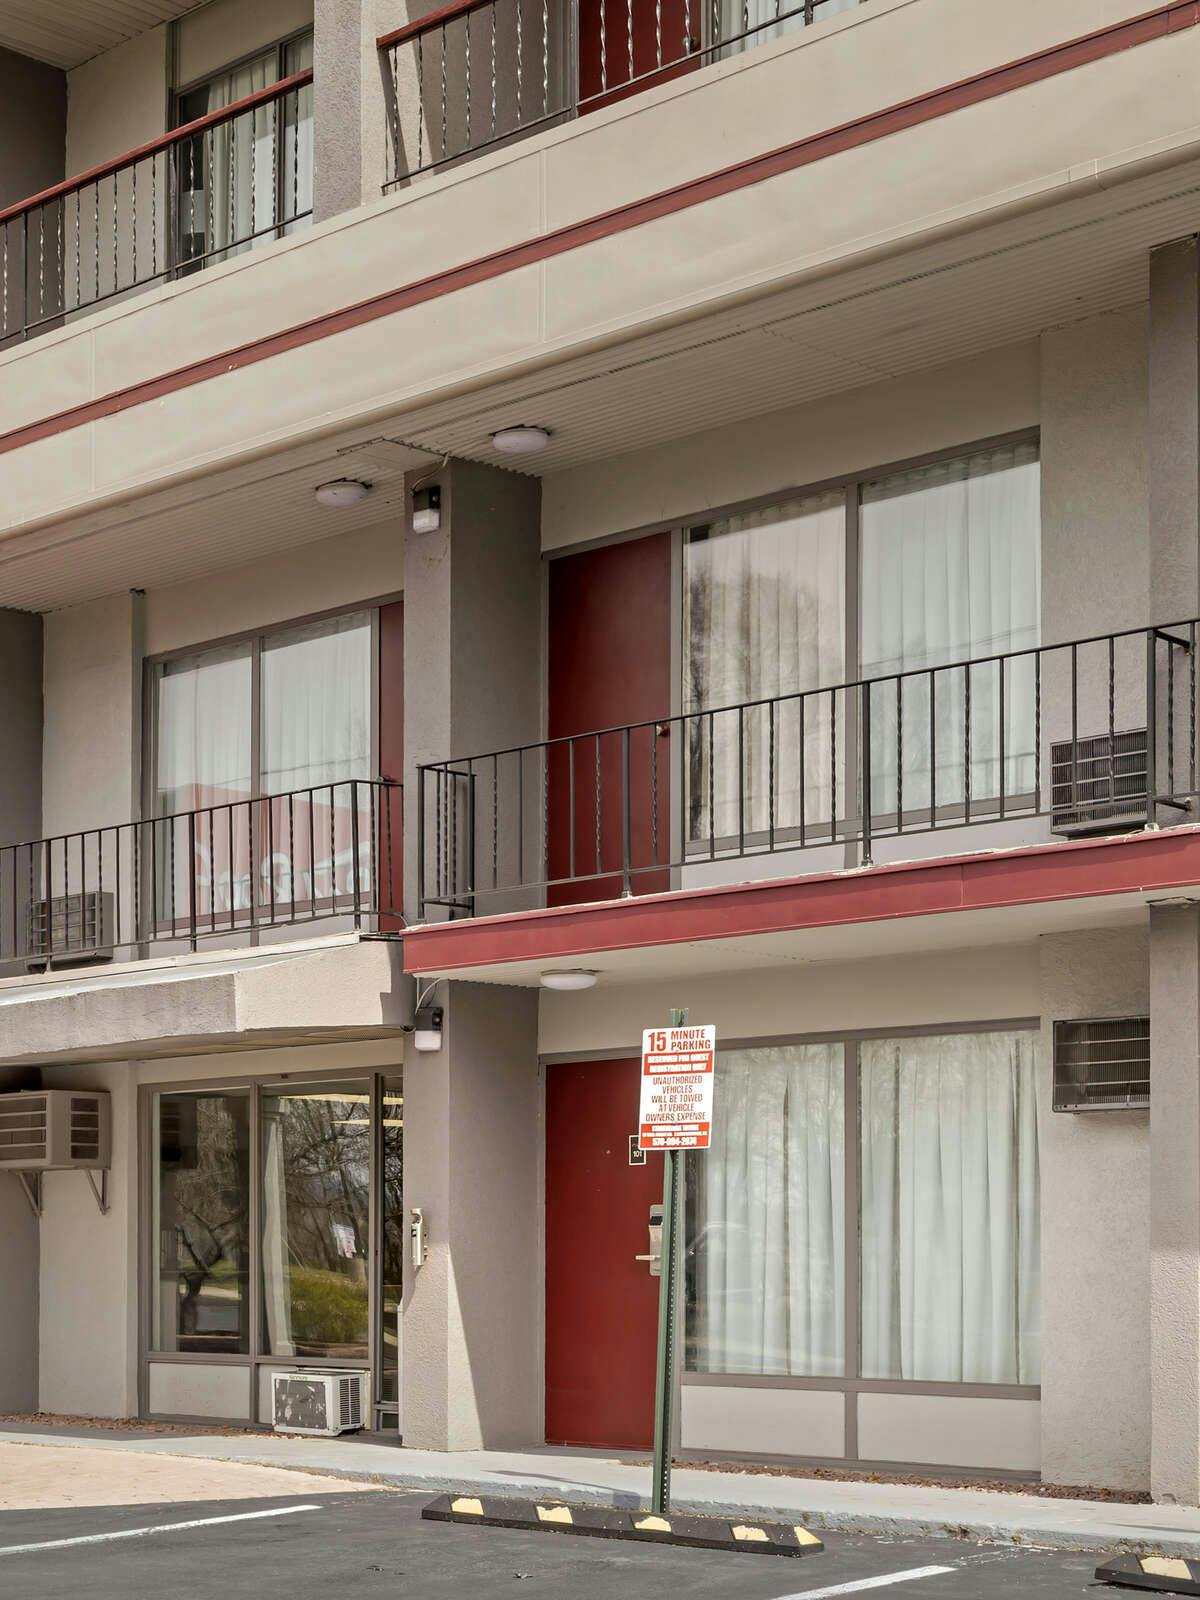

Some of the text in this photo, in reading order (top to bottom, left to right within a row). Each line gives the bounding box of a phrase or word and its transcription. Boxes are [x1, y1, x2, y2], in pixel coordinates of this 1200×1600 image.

[670, 1029, 705, 1040] MINUTE
[648, 1031, 667, 1052] 15
[670, 1039, 711, 1051] PARKING
[652, 1075, 703, 1085] UNAUTHORIZED
[662, 1085, 693, 1094] VEHICLES
[651, 1094, 703, 1104] WILL BE TOWED
[658, 1103, 694, 1112] AT VEHICLE
[645, 1111, 705, 1121] OWNERS EXPENSE
